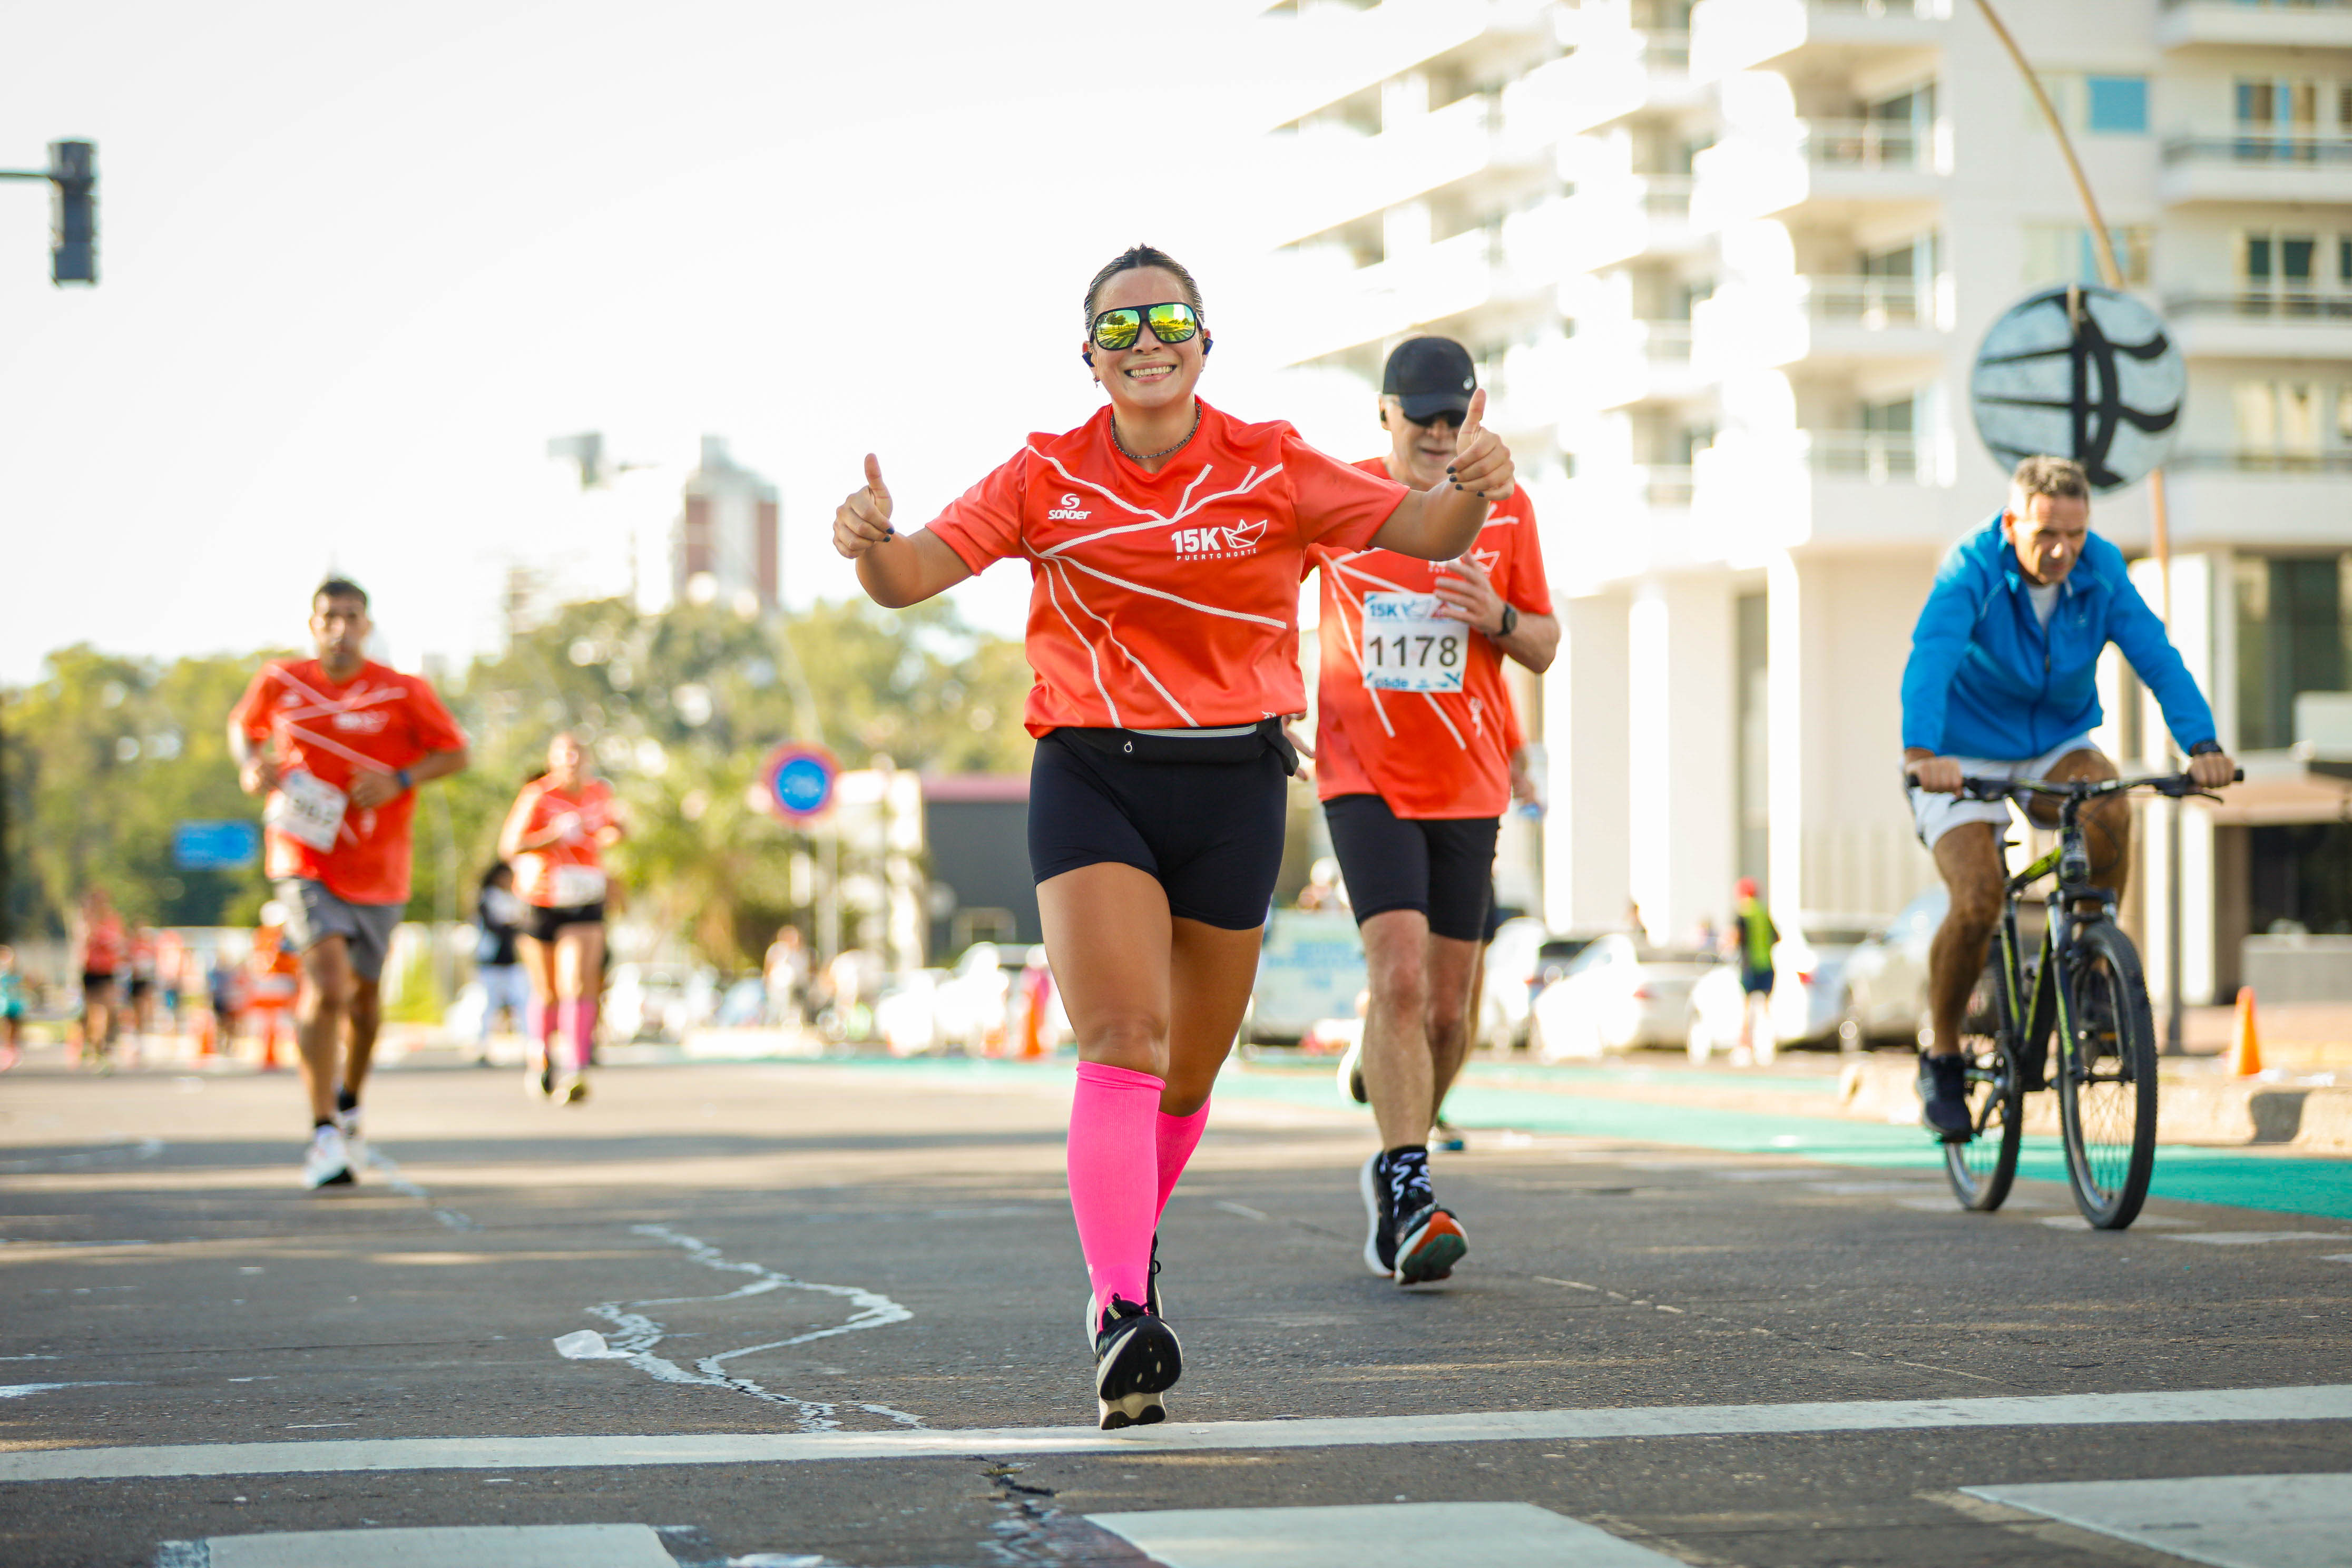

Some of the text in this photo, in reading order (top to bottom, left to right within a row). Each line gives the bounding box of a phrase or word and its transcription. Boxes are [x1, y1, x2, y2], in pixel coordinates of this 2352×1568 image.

[1171, 527, 1221, 553] 15K
[1177, 548, 1257, 561] PUERTO NORTE
[1370, 603, 1398, 616] 15K
[1369, 635, 1458, 667] 1178
